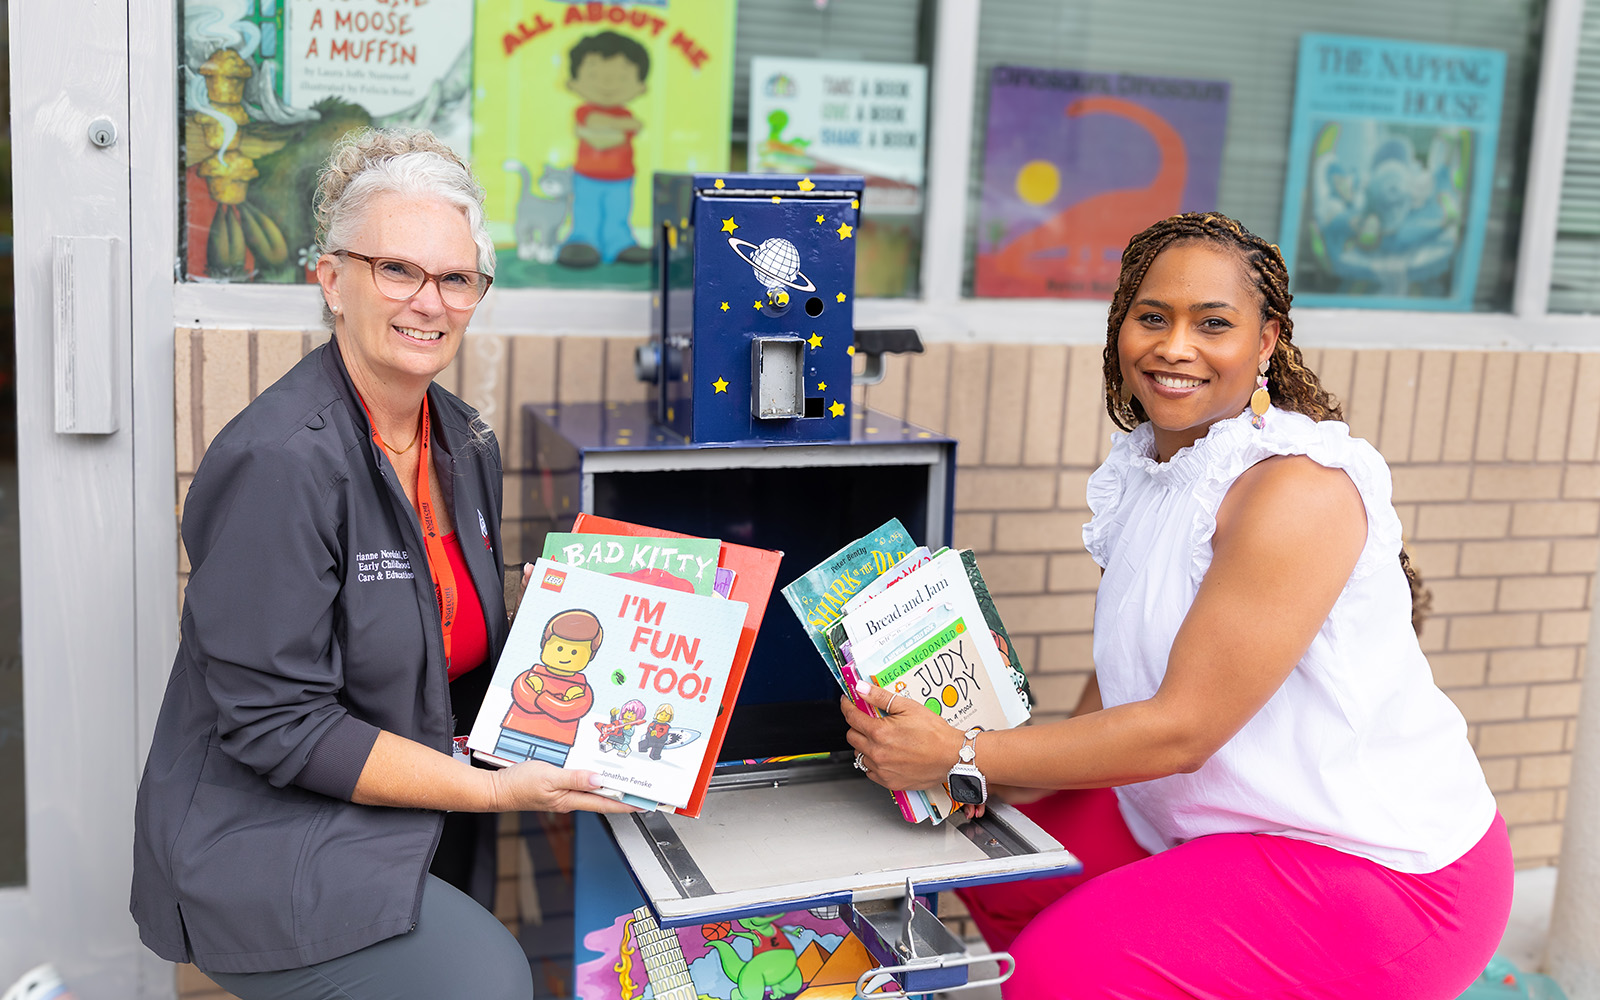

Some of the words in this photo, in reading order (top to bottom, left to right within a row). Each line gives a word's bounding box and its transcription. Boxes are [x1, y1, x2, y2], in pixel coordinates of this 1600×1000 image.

[310, 9, 322, 31] A
[335, 10, 413, 35] MOOSE
[501, 14, 554, 56] ALL
[563, 2, 667, 36] ABOUT
[670, 31, 710, 70] ME
[305, 38, 319, 59] A
[330, 39, 417, 65] MUFFIN
[1317, 44, 1371, 76] THE
[1378, 49, 1491, 87] NAPPING
[1402, 88, 1486, 119] HOUSE
[357, 573, 376, 582] Care
[376, 571, 384, 581] &
[358, 561, 379, 571] Early
[562, 541, 631, 568] BAD
[629, 544, 714, 584] KITTY
[830, 558, 846, 574] Peter
[846, 546, 868, 562] Bently
[544, 575, 563, 586] LEGO
[807, 569, 862, 633] SHARK
[860, 562, 874, 576] THE
[618, 594, 666, 626] I'M
[866, 604, 902, 636] Bread
[902, 589, 924, 614] and
[924, 579, 949, 602] Jam
[629, 626, 704, 671] FUN,
[880, 660, 912, 687] MEGAN
[912, 629, 956, 665] McDONALD
[638, 662, 712, 703] TOO!
[913, 640, 968, 697] JUDY
[600, 770, 629, 782] Jonathan
[629, 776, 652, 788] Fenske
